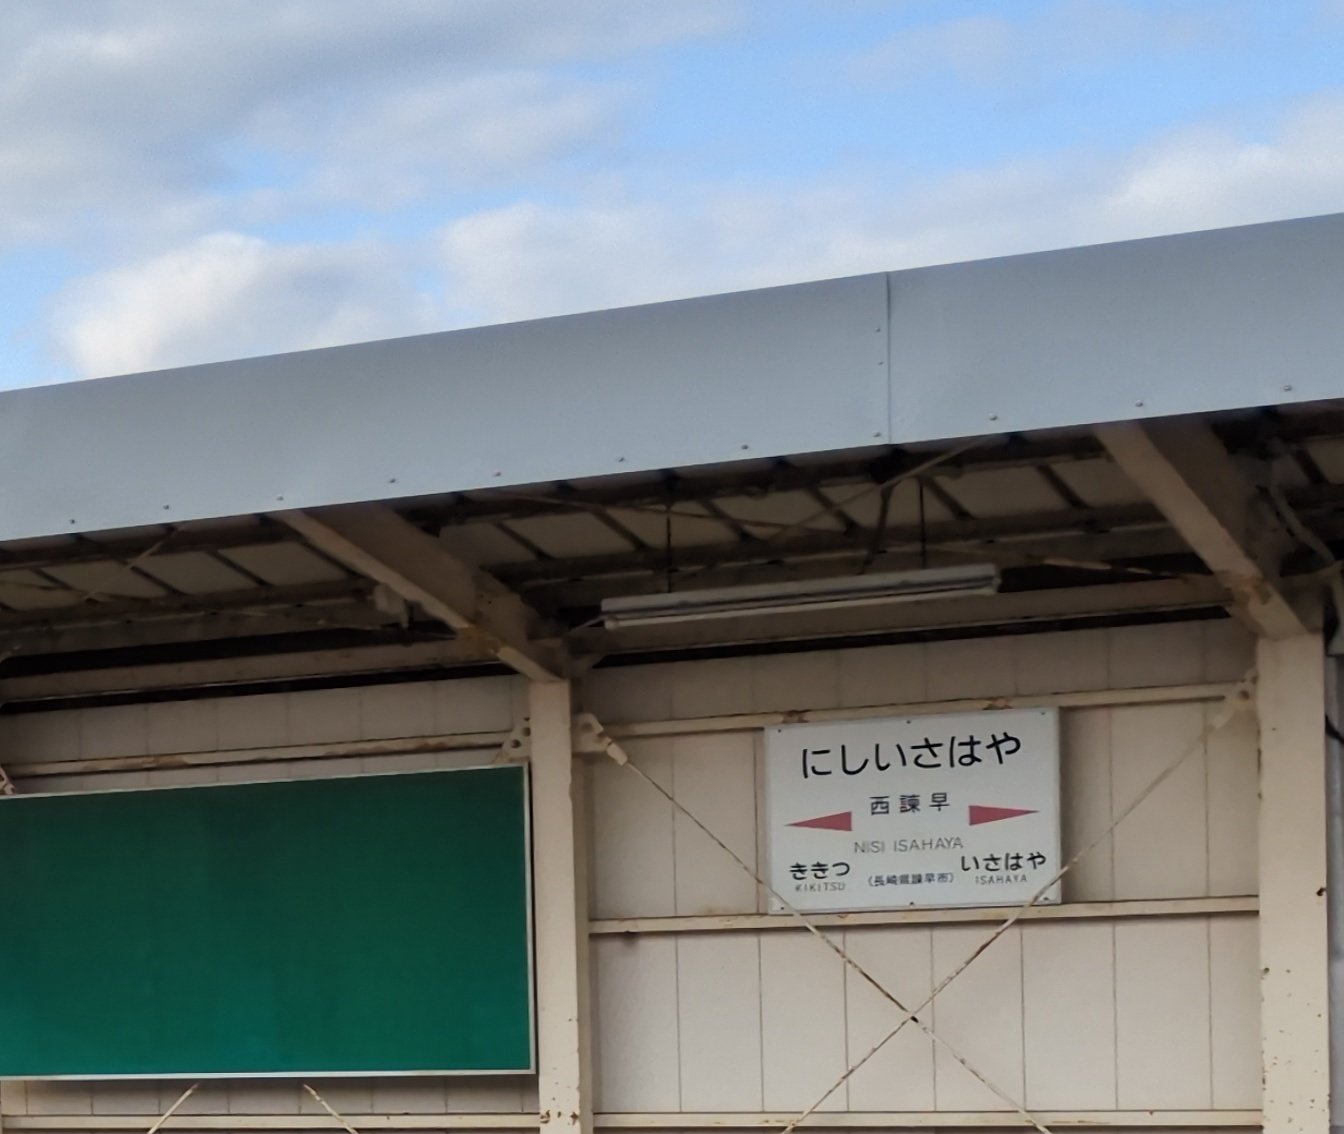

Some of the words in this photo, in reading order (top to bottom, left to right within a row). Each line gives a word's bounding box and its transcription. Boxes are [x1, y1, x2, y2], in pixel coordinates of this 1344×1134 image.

[801, 731, 1022, 779] にしいさはや
[853, 840, 886, 854] NISI
[893, 837, 964, 852] ISAHAYA
[789, 860, 850, 880] ききつ
[961, 851, 1047, 872] いさはや
[794, 881, 846, 892] KIKITSU
[975, 873, 1028, 885] ISAHAYA
